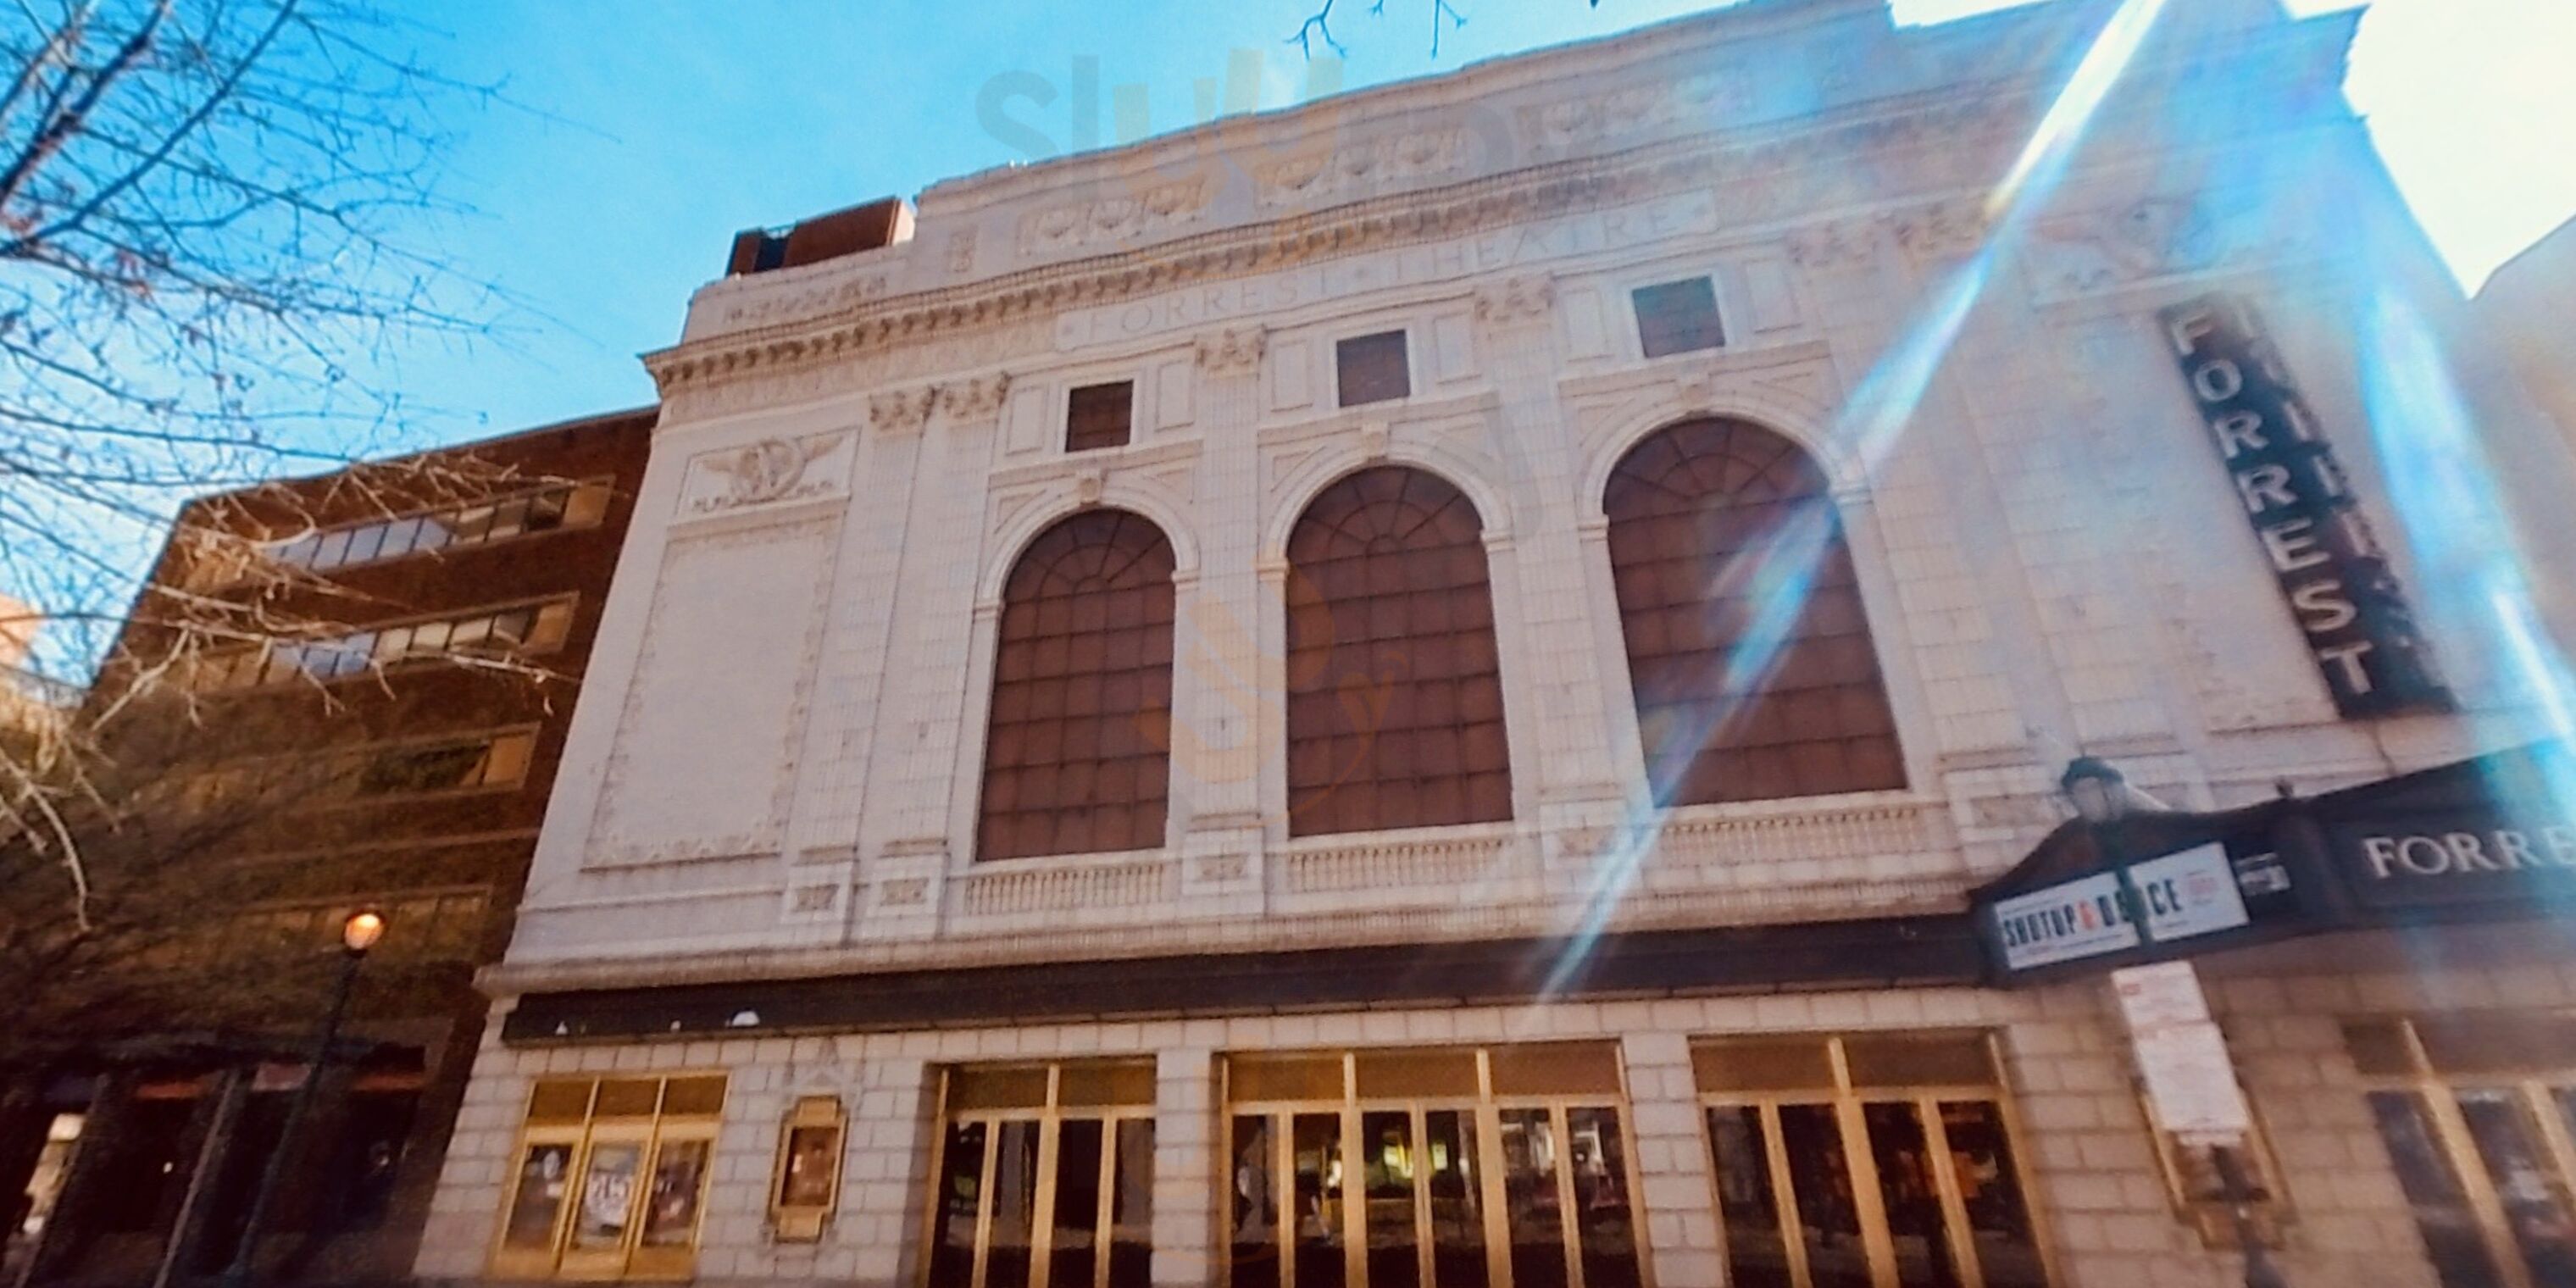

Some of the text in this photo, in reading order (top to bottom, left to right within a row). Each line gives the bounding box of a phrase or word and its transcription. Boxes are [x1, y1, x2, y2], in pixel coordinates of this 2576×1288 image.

[1090, 208, 1685, 336] FORREST THEATRE
[2169, 312, 2373, 695] FORREST
